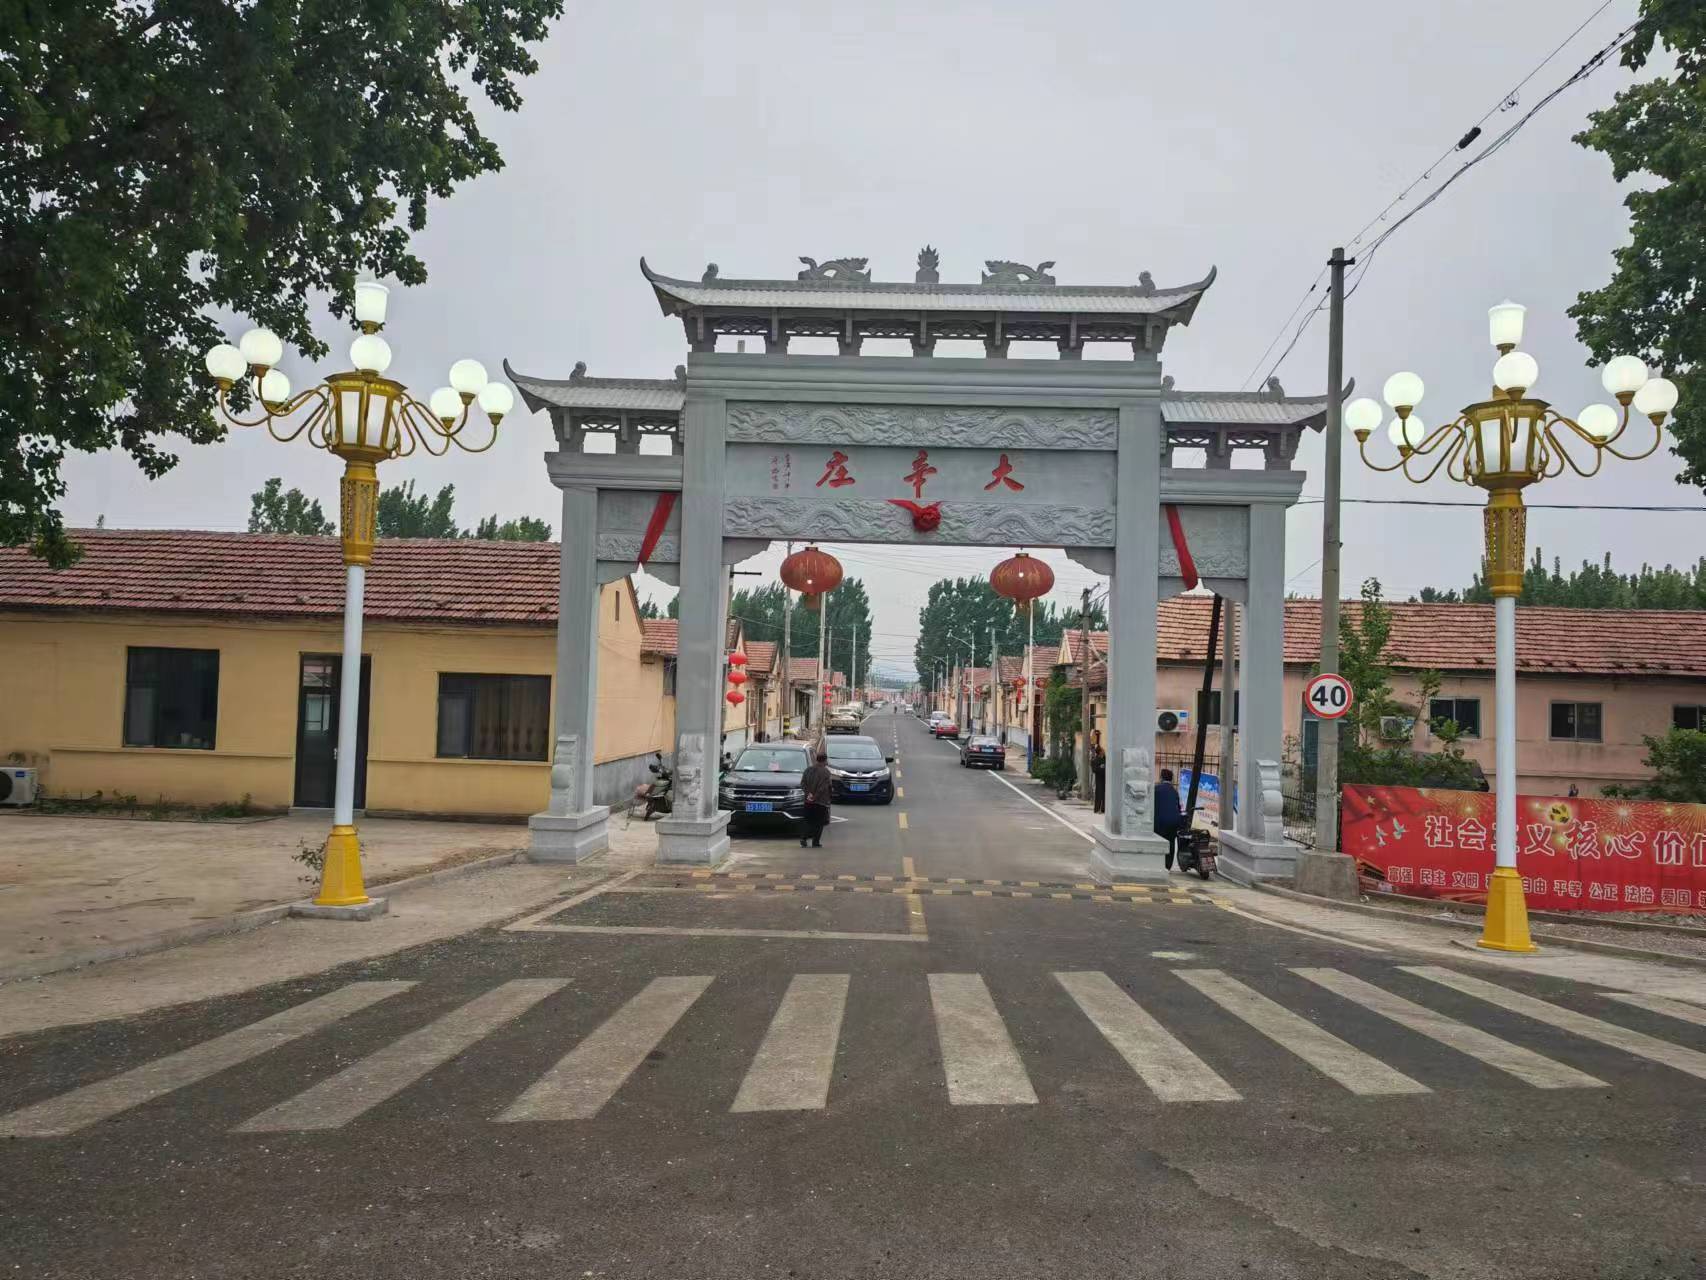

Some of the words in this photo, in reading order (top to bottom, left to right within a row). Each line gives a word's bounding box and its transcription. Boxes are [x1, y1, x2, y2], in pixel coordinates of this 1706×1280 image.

[1311, 685, 1347, 707] 40
[1424, 814, 1706, 868] 社会义核心价
[1388, 865, 1414, 884] 富强
[1420, 868, 1446, 886] 民主
[1452, 870, 1480, 889] 文明
[1521, 877, 1547, 895] 自由
[1553, 879, 1583, 898] 平等
[1589, 882, 1618, 901] 公正
[1624, 885, 1655, 904] 法治
[1661, 888, 1692, 907] 爱国
